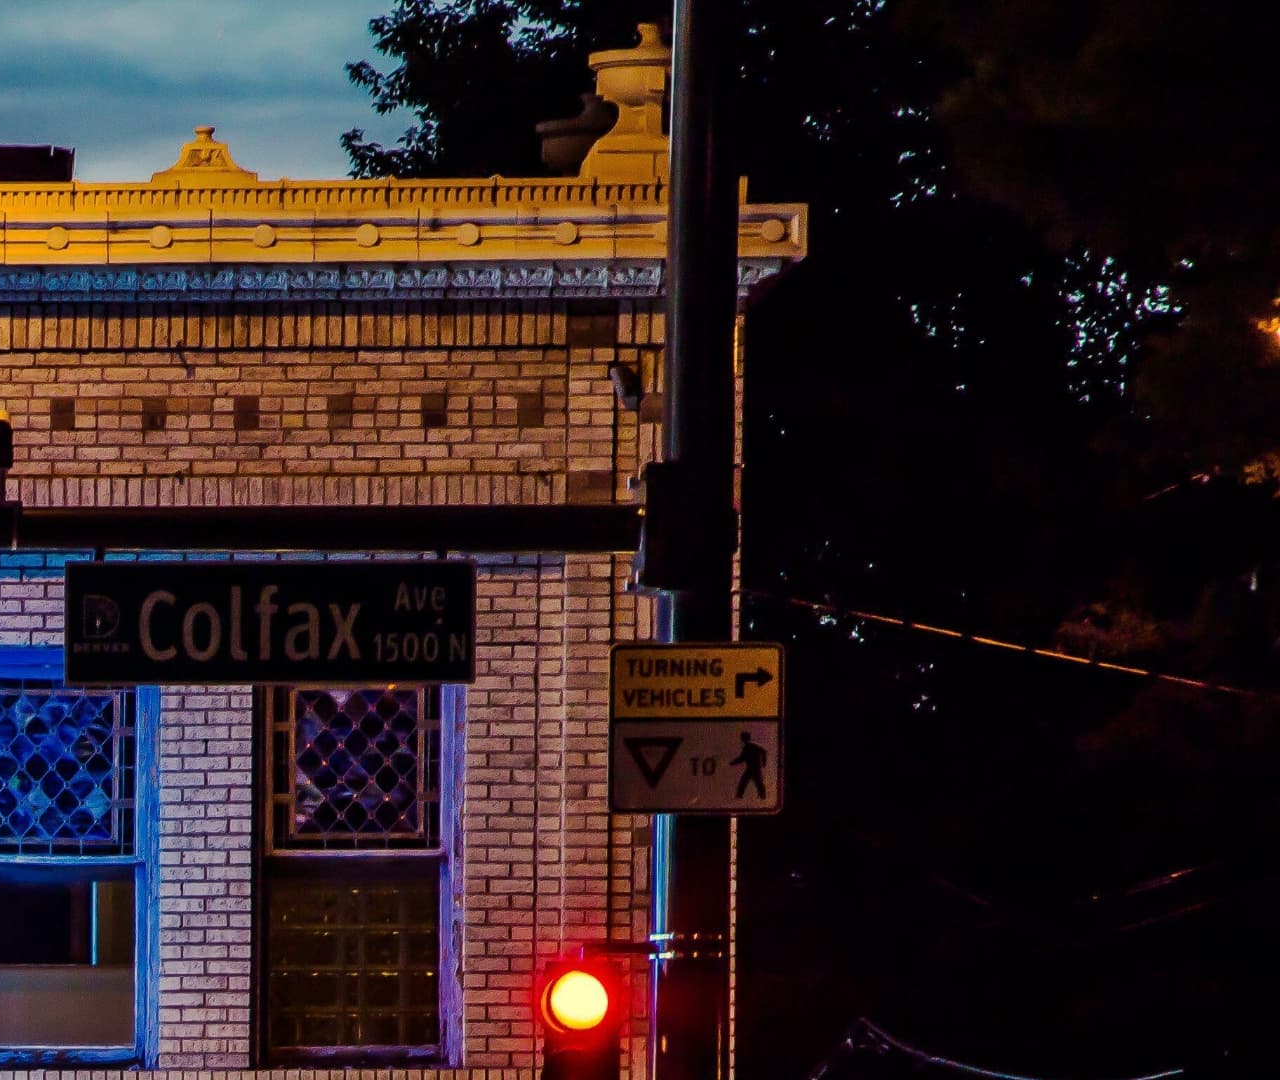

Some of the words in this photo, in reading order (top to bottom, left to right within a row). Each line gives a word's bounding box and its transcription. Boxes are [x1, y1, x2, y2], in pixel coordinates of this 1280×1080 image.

[139, 584, 361, 661] Colfax
[394, 582, 446, 612] Ave
[373, 632, 439, 662] 1500
[449, 632, 467, 662] N
[626, 658, 724, 678] TURNING
[622, 688, 726, 708] VEHICLES
[691, 756, 717, 777] TO
